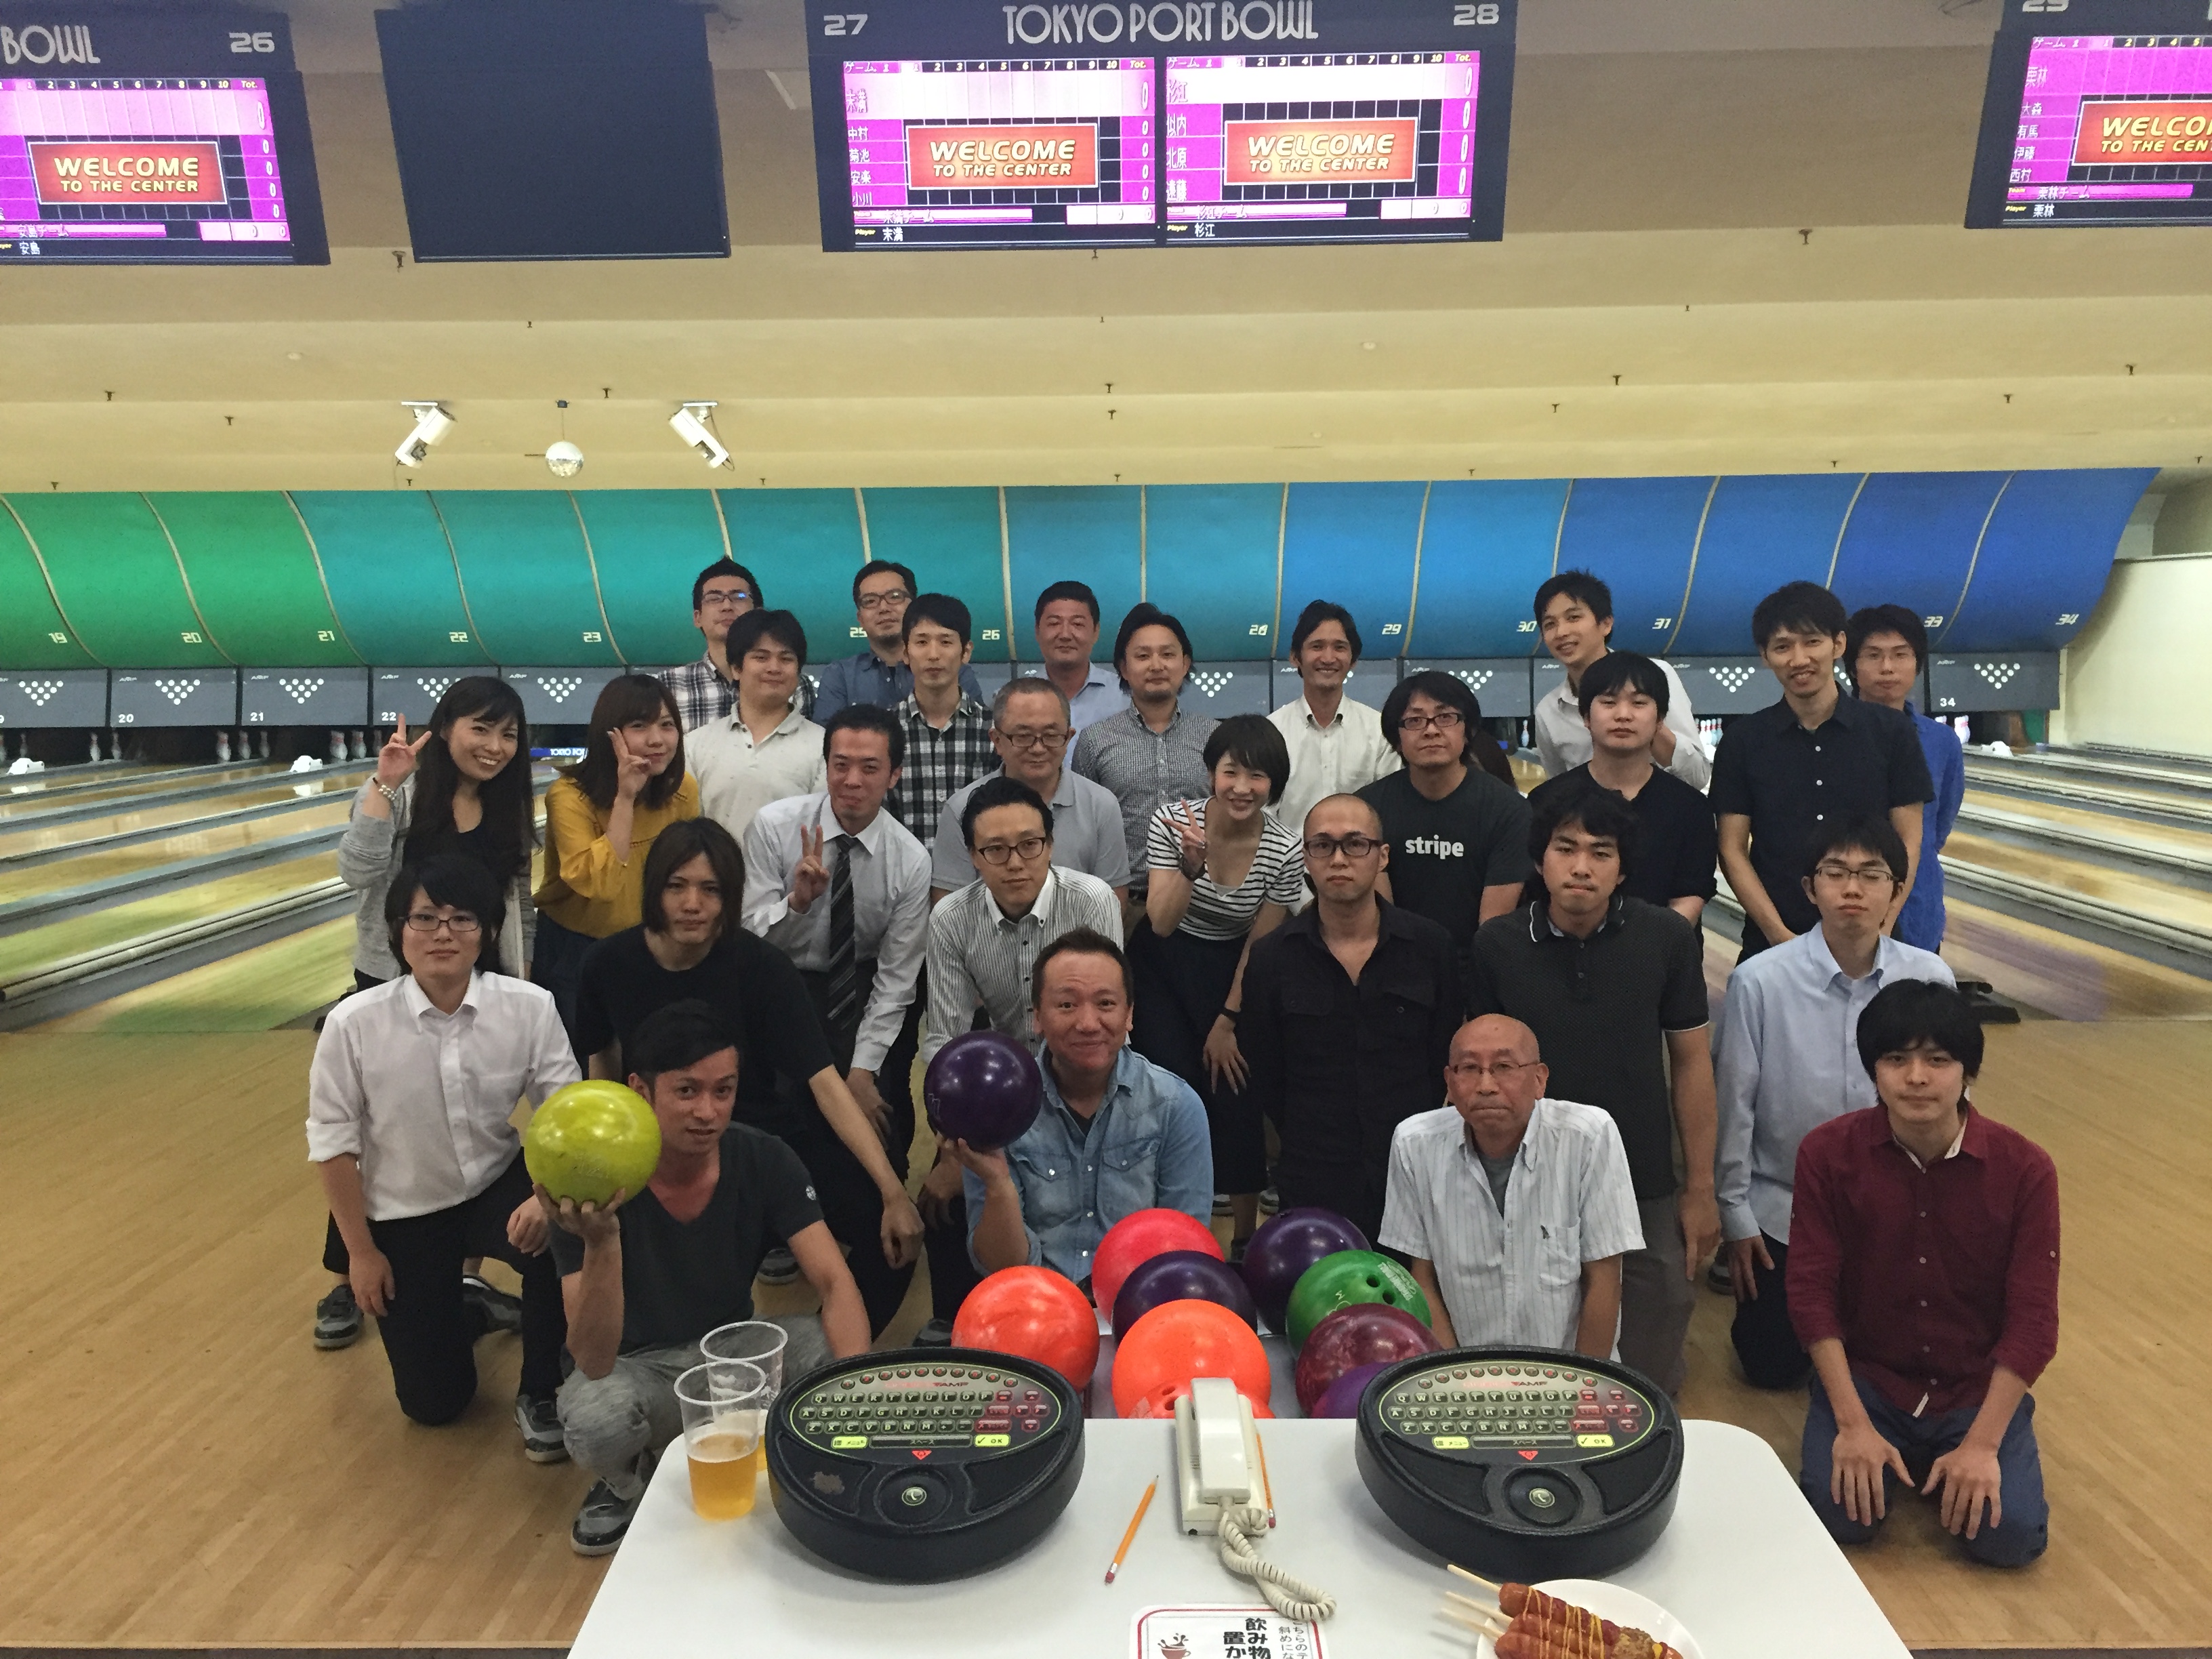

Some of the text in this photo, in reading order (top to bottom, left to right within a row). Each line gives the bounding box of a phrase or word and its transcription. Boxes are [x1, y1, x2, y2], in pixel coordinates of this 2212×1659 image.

[1002, 0, 1318, 44] TOKYO PORT BOWL
[1453, 4, 1499, 26] 28
[824, 14, 868, 36] 27
[0, 25, 100, 64] BOWL
[229, 32, 275, 53] 26
[2124, 39, 2132, 47] 2
[2147, 38, 2155, 47] 3
[2170, 38, 2177, 46] 4
[2193, 38, 2200, 46] 5
[934, 63, 941, 72] 2
[956, 62, 963, 71] 3
[978, 62, 985, 71] 4
[1000, 62, 1007, 70] 5
[1022, 62, 1029, 70] 6
[1044, 61, 1050, 70] 7
[1066, 61, 1073, 69] 8
[1088, 60, 1096, 69] 9
[1106, 60, 1118, 68] 10
[1130, 60, 1147, 68] Tot.
[1257, 58, 1265, 66] 2
[1279, 58, 1286, 66] 3
[1301, 57, 1309, 66] 4
[1324, 57, 1331, 65] 5
[1346, 56, 1353, 65] 6
[1368, 56, 1375, 64] 7
[1391, 56, 1397, 64] 8
[1412, 55, 1420, 64] 9
[1431, 54, 1442, 62] 10
[1454, 54, 1471, 62] Tot.
[135, 81, 141, 89] 6
[157, 81, 163, 89] 7
[178, 81, 185, 89] 8
[200, 81, 207, 89] 9
[218, 81, 229, 89] 10
[241, 81, 258, 89] Tot.
[1465, 66, 1473, 96] 0
[1142, 81, 1149, 110] 0
[258, 102, 265, 129] 0
[1462, 100, 1471, 129] 0
[2021, 102, 2043, 116] 大森
[848, 126, 868, 140] 中村
[1141, 120, 1148, 136] 0
[2017, 125, 2039, 138] 有馬
[2103, 116, 2212, 137] WELCO
[263, 140, 269, 153] 0
[930, 140, 1076, 161] WELCOME
[1142, 142, 1148, 158] 0
[1248, 134, 1395, 157] WELCOME
[1460, 134, 1468, 162] 0
[2102, 140, 2212, 152] TO THE CEN
[2014, 146, 2036, 160] 伊藤
[54, 157, 199, 177] WELCOME
[266, 161, 272, 176] 0
[933, 163, 1071, 178] TO THE CENTER
[1250, 157, 1389, 172] TO THE CENTER
[1141, 164, 1148, 180] 0
[2009, 167, 2032, 182] 西村
[60, 180, 199, 192] TO THE CENTER
[1458, 167, 1466, 194] 0
[270, 183, 276, 197] 0
[1141, 186, 1148, 201] 0
[853, 192, 872, 206] 小川
[273, 204, 280, 218] 0
[2033, 203, 2055, 218] 栗林
[1194, 222, 1215, 237] 杉江
[19, 241, 41, 255] 安島
[1516, 620, 1538, 632] 30
[1652, 619, 1672, 630] 31
[1923, 615, 1944, 628] 33
[2055, 614, 2080, 626] 34
[318, 630, 335, 642] 21
[850, 627, 868, 638] 25
[982, 630, 1000, 640] 26
[1382, 624, 1402, 635] 29
[49, 632, 68, 644] 19
[182, 632, 203, 644] 20
[449, 632, 468, 643] 22
[583, 632, 602, 643] 23
[1940, 697, 1957, 707] 34
[119, 714, 134, 723] 20
[250, 712, 264, 722] 21
[382, 712, 396, 721] 22
[1405, 834, 1464, 860] stripe
[1223, 1631, 1246, 1659] 置か
[1245, 1618, 1271, 1659] 飲み物
